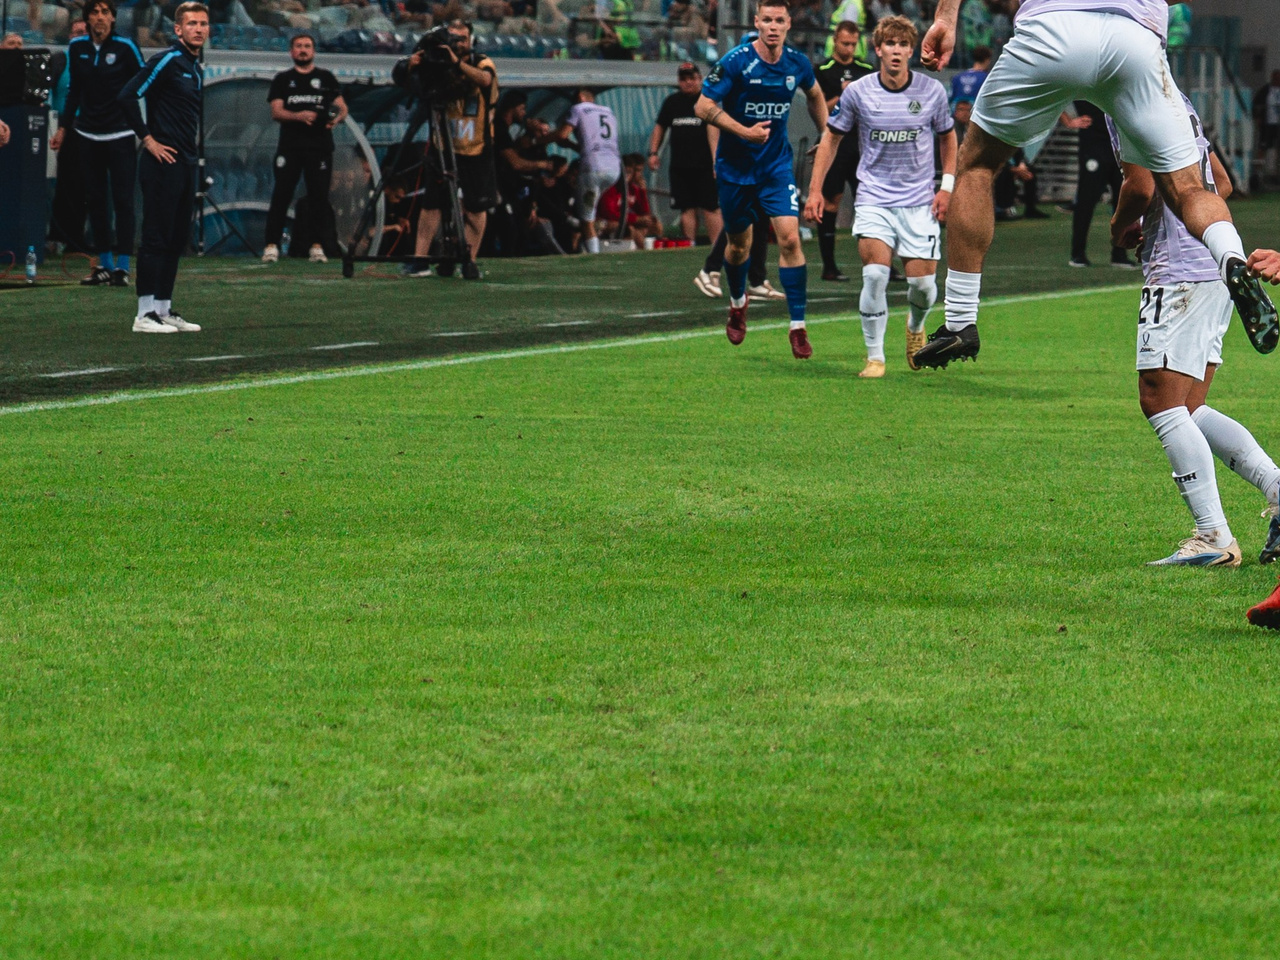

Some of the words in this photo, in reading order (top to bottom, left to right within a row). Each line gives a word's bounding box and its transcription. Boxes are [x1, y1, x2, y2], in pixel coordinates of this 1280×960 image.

[599, 115, 611, 139] 5
[928, 235, 936, 258] 7
[1138, 287, 1165, 324] 21
